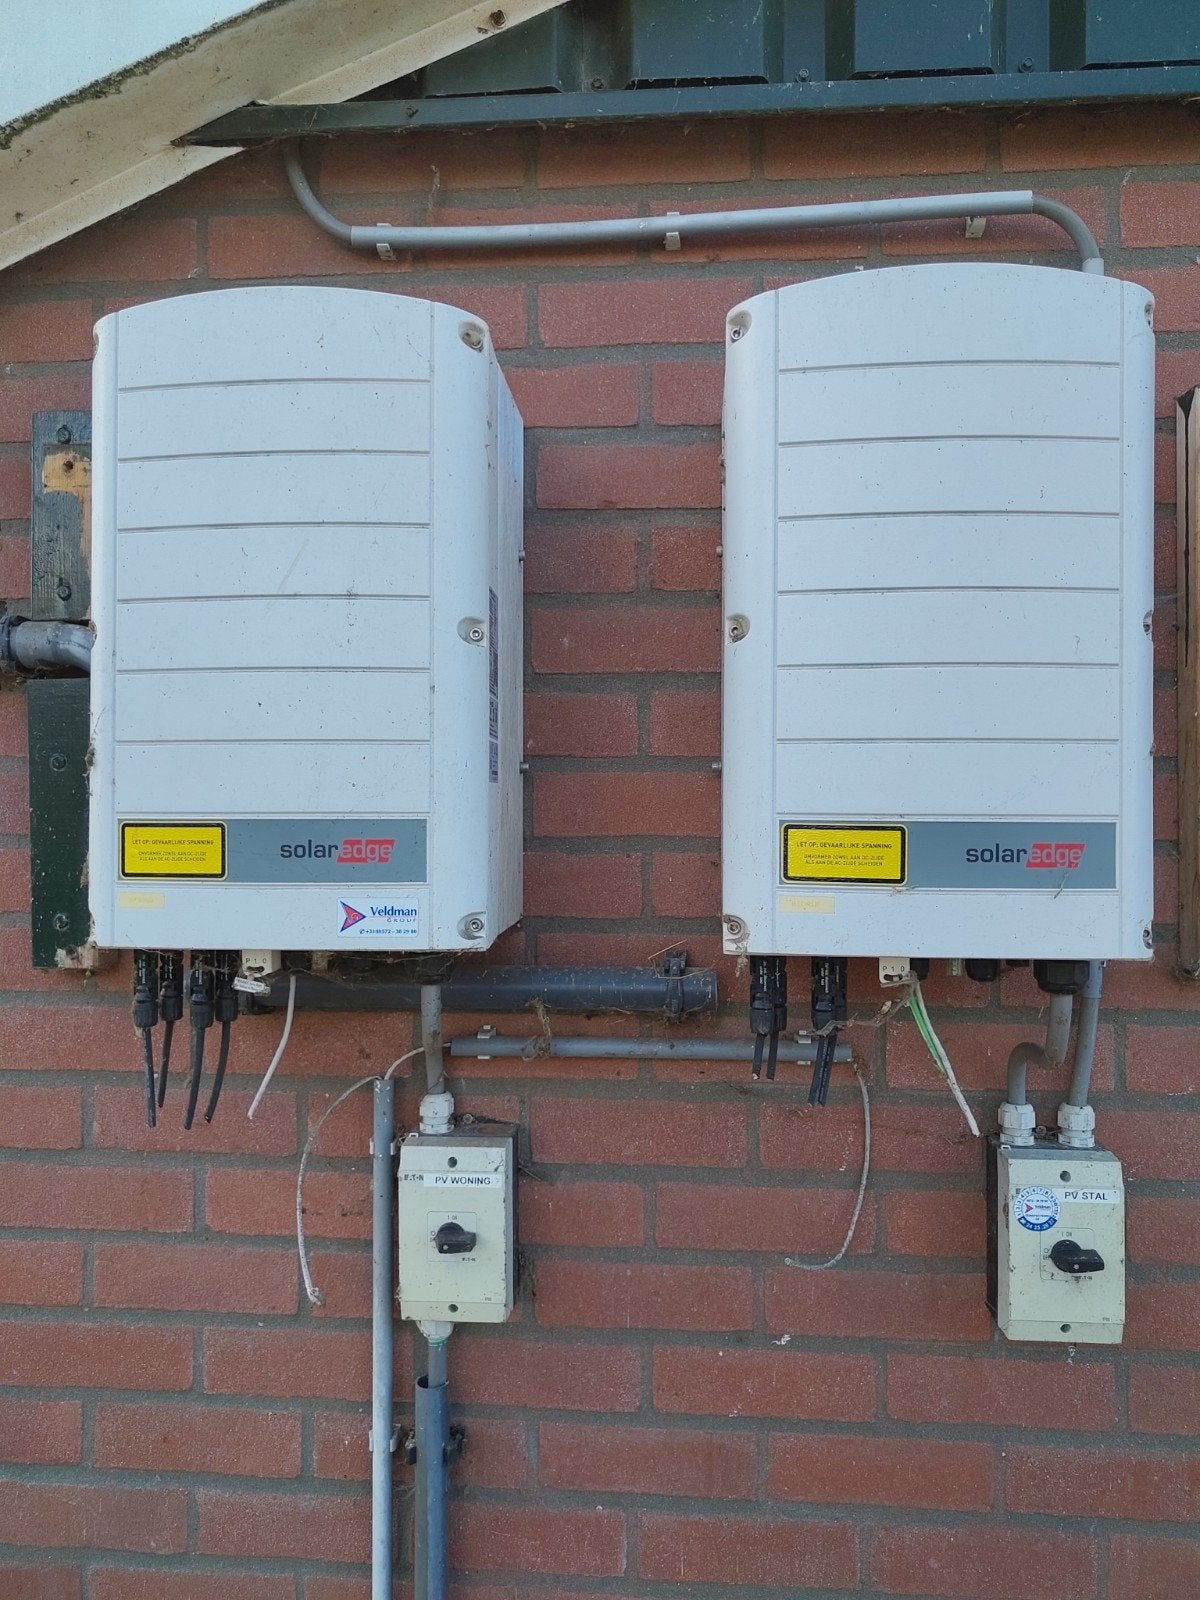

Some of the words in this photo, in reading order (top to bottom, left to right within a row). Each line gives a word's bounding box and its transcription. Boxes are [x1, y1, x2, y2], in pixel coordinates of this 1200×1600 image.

[369, 906, 417, 916] Veldman
[435, 1176, 448, 1184] PV
[450, 1176, 491, 1185] WONING
[1064, 1191, 1079, 1200] PV
[1081, 1191, 1108, 1201] STAL
